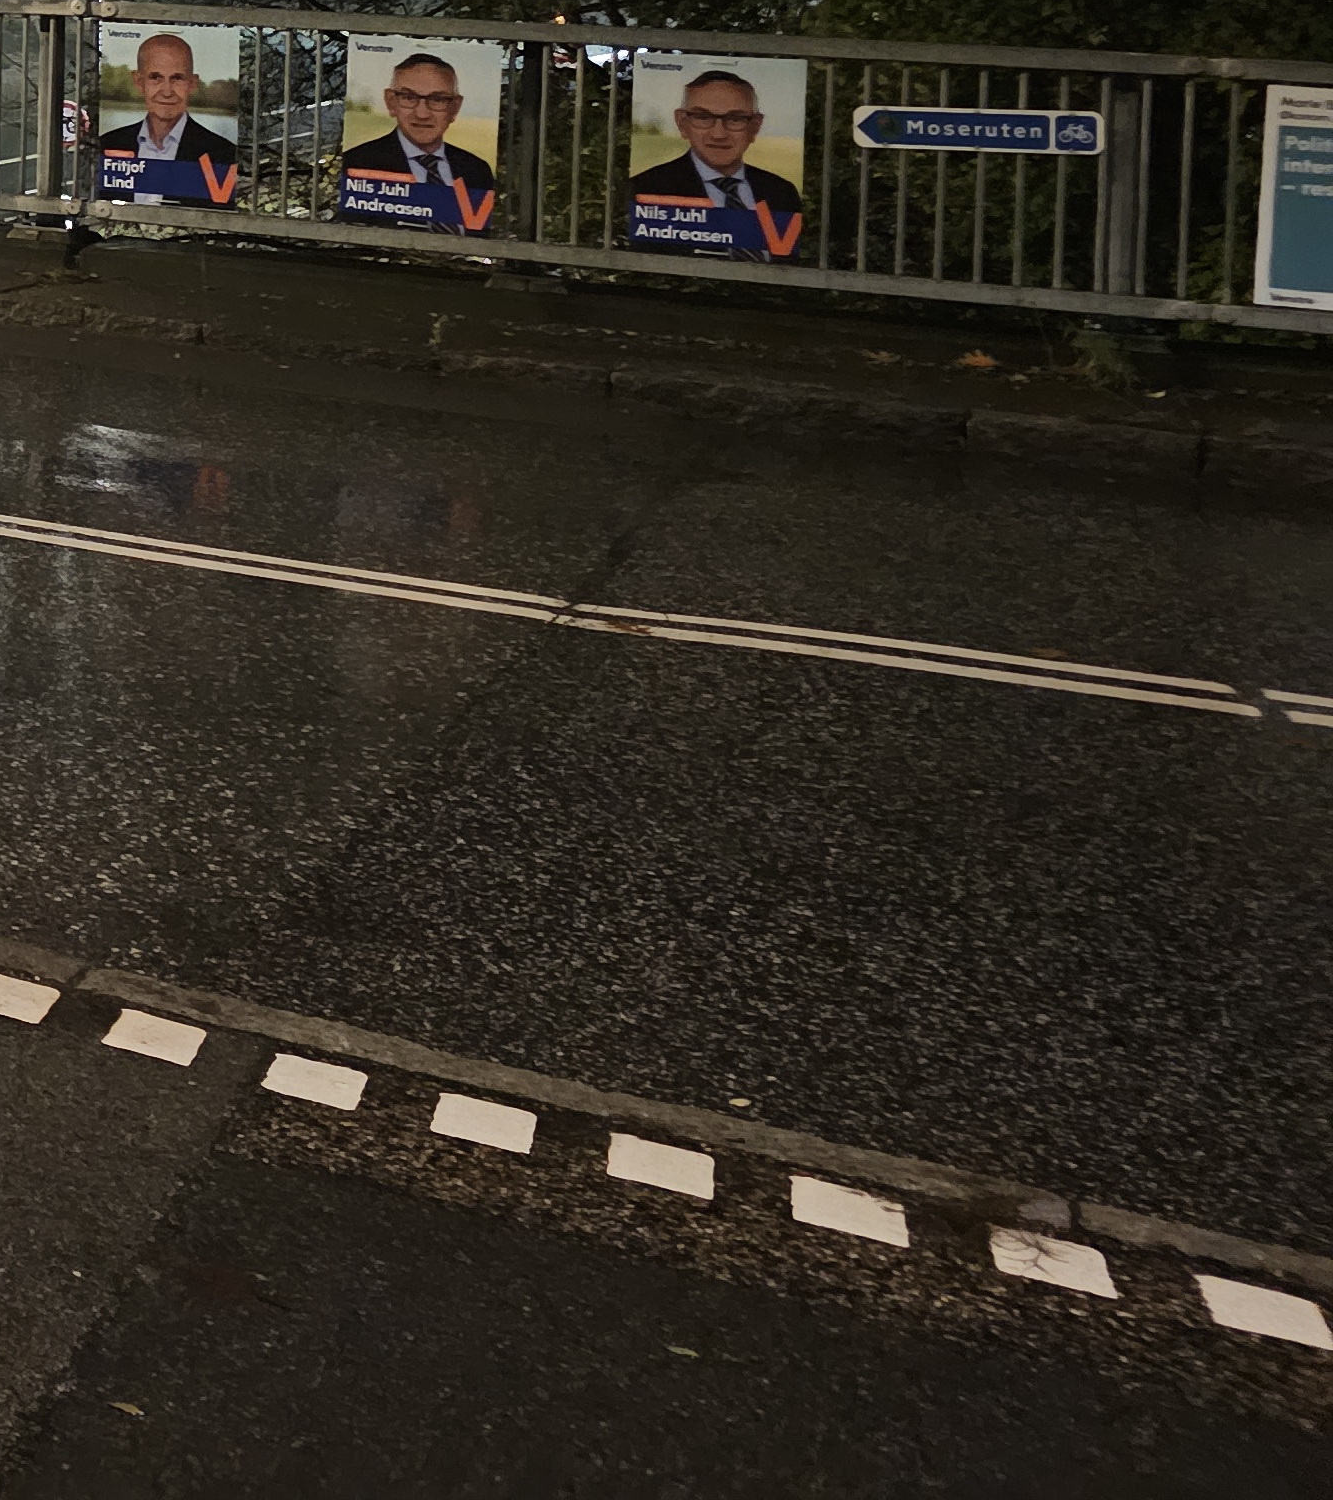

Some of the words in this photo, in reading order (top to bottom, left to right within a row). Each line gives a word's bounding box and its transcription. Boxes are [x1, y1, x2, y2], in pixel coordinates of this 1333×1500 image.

[107, 29, 141, 39] Venstre
[355, 41, 393, 53] Venstre
[641, 59, 683, 71] Venstre
[906, 120, 1042, 138] Moseruten
[103, 158, 145, 176] Fritjof
[103, 175, 134, 189] Lind
[346, 178, 374, 194] Nils
[377, 182, 409, 198] Juhl
[345, 195, 433, 217] Andreasen
[635, 204, 668, 221] Nils
[670, 208, 707, 223] Juhl
[635, 223, 733, 244] Andreasen
